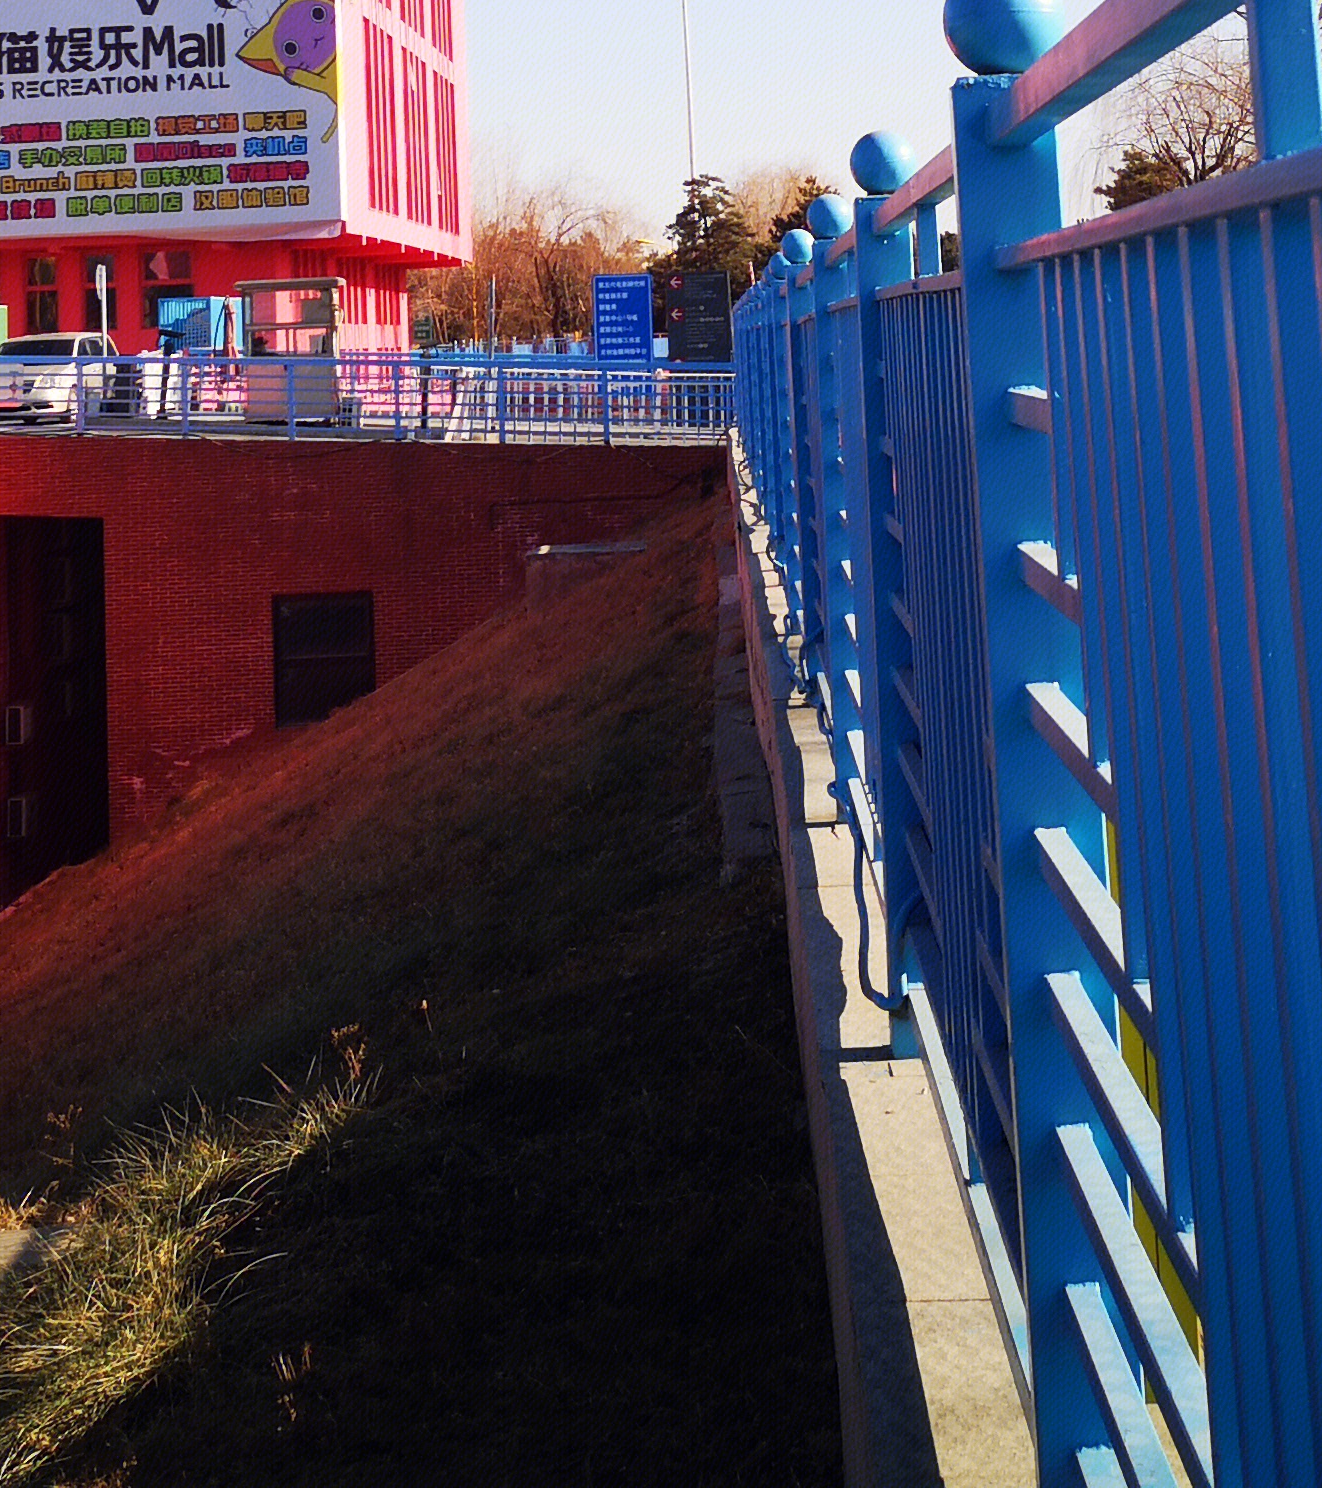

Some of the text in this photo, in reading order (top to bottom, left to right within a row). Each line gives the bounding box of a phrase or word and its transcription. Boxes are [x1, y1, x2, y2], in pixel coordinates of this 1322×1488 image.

[12, 73, 158, 100] RECREATION
[165, 70, 231, 92] MALL
[66, 117, 150, 141] 换装自拍
[155, 112, 239, 136] 视觉工场
[243, 109, 307, 132] 聊天吧
[18, 142, 127, 168] 手办交易所
[244, 135, 308, 157] 夹机占
[0, 172, 71, 195] Brunch
[74, 168, 137, 191] 麻辣烫
[140, 164, 224, 188] 回转火锅
[65, 192, 183, 218] 脱单便利店
[193, 186, 310, 211] 汉服体验馆
